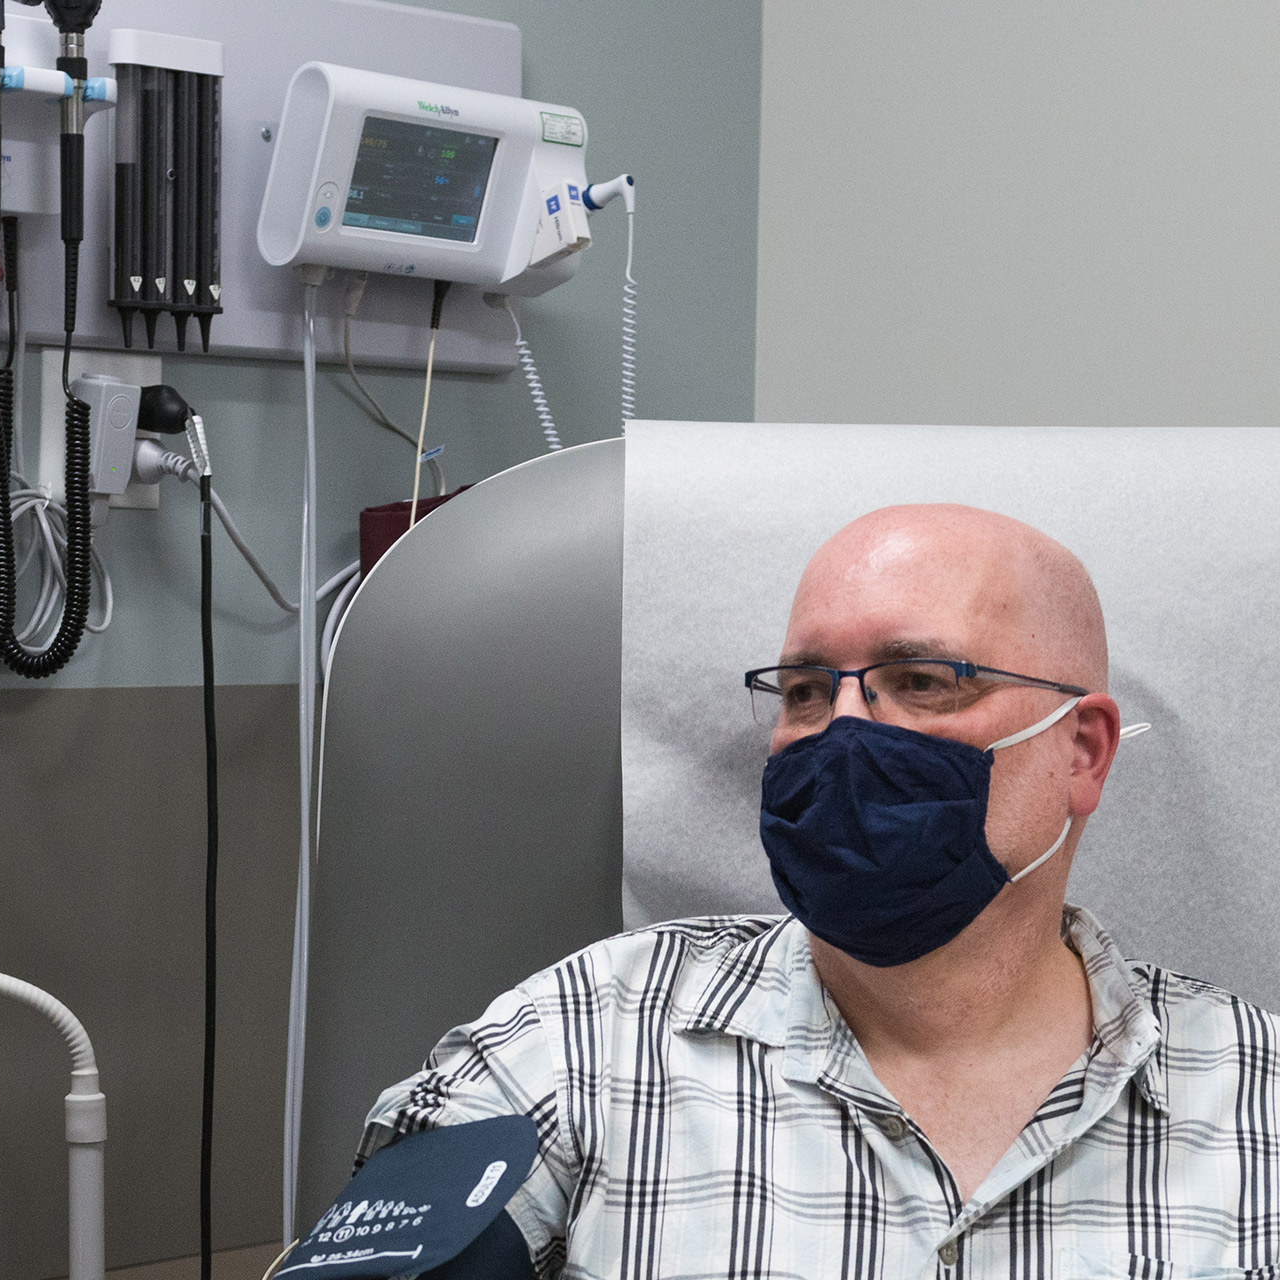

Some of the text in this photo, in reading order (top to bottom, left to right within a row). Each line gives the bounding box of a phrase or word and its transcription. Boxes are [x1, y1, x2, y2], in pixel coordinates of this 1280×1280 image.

[318, 1231, 332, 1242] 12
[355, 1225, 370, 1237] 10
[371, 1223, 382, 1234] 9
[385, 1221, 395, 1231] 8
[398, 1219, 409, 1229] 7
[412, 1216, 423, 1226] 6
